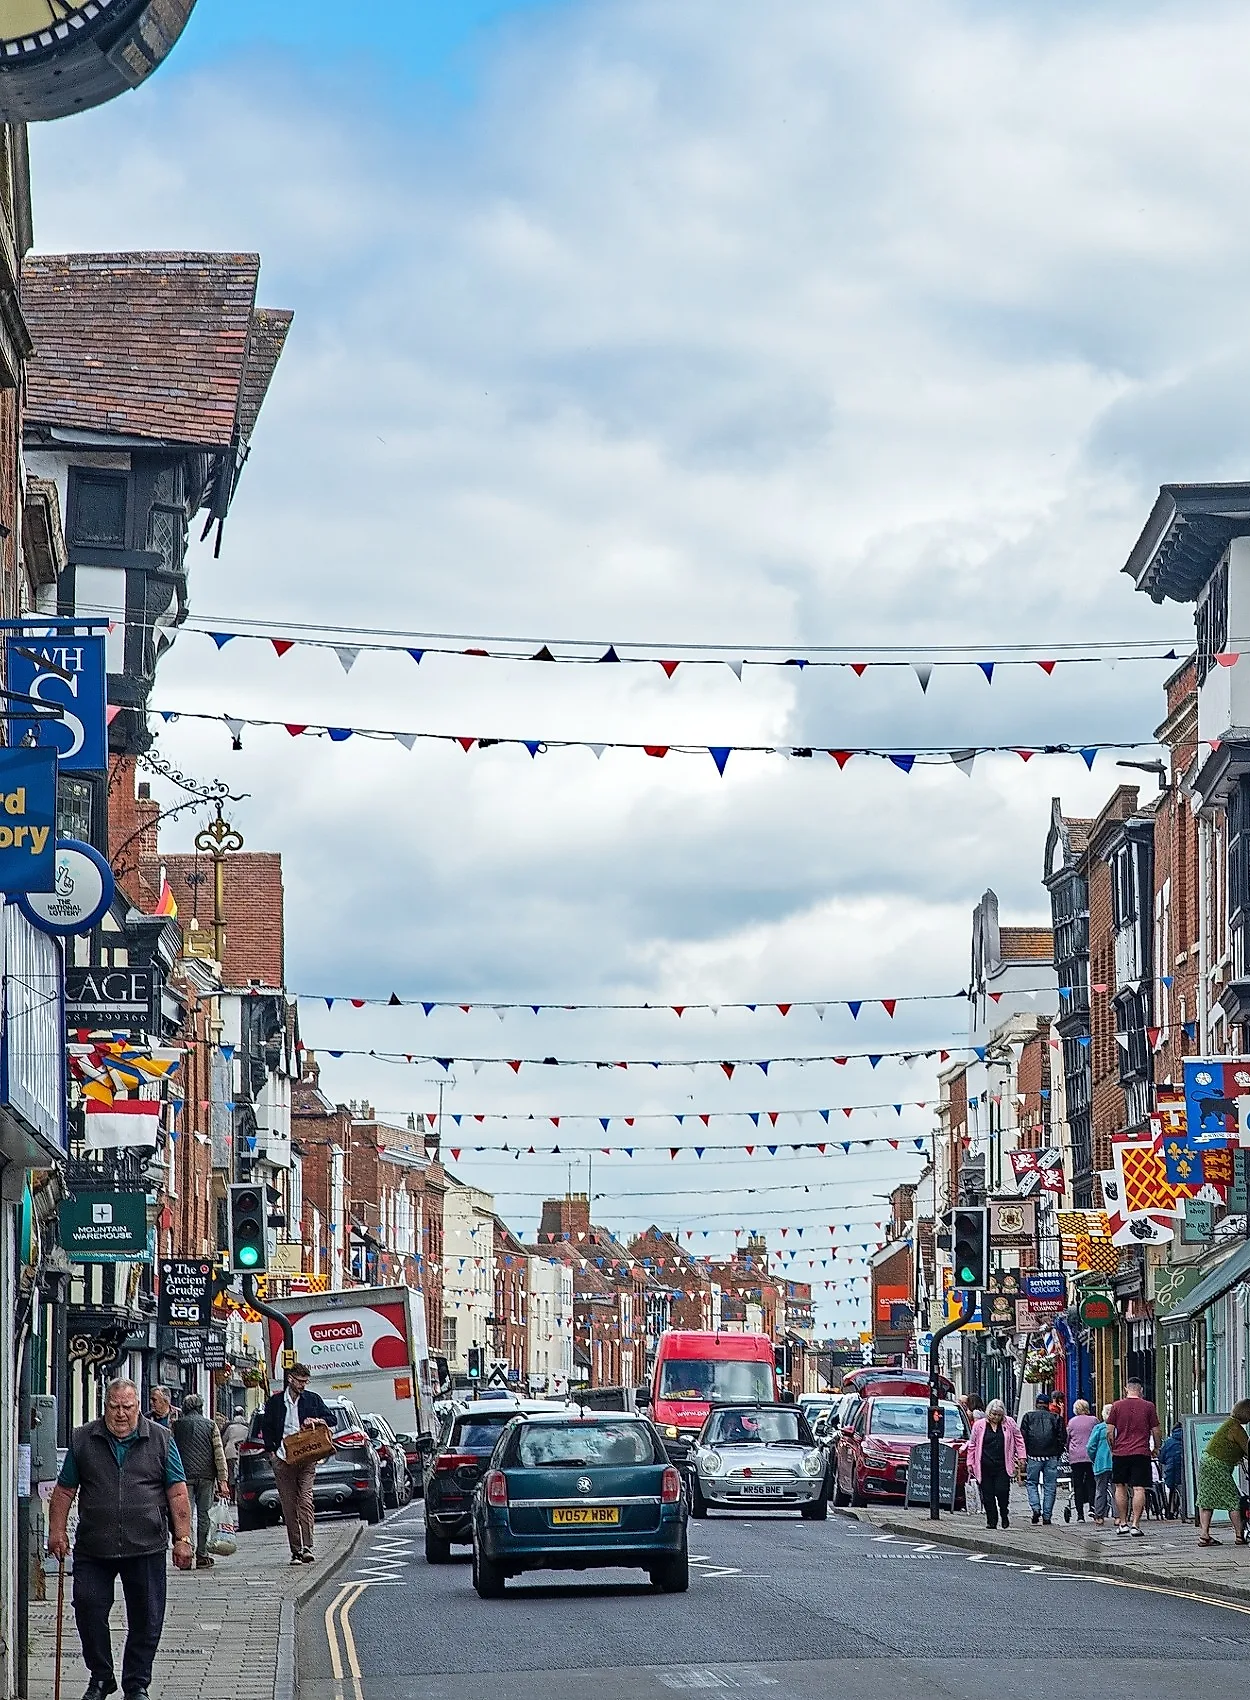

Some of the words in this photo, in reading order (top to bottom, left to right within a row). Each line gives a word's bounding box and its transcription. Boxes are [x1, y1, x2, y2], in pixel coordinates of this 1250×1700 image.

[28, 647, 84, 672] WH
[29, 672, 85, 760] S
[0, 787, 26, 815] d
[64, 972, 149, 1002] AGE
[78, 1226, 128, 1234] MOUNTAIN
[72, 1232, 133, 1241] WAREHOUSE
[174, 1263, 197, 1275] The
[165, 1274, 206, 1285] Ancient
[1030, 1278, 1060, 1287] scrivens
[166, 1284, 206, 1298] Grudge
[1030, 1286, 1060, 1294] opticians
[170, 1303, 200, 1322] tag
[313, 1322, 360, 1339] eurocell
[323, 1341, 365, 1353] RECYCLE
[292, 1442, 322, 1458] adidas
[766, 1486, 780, 1494] BNE
[557, 1510, 588, 1521] VO57
